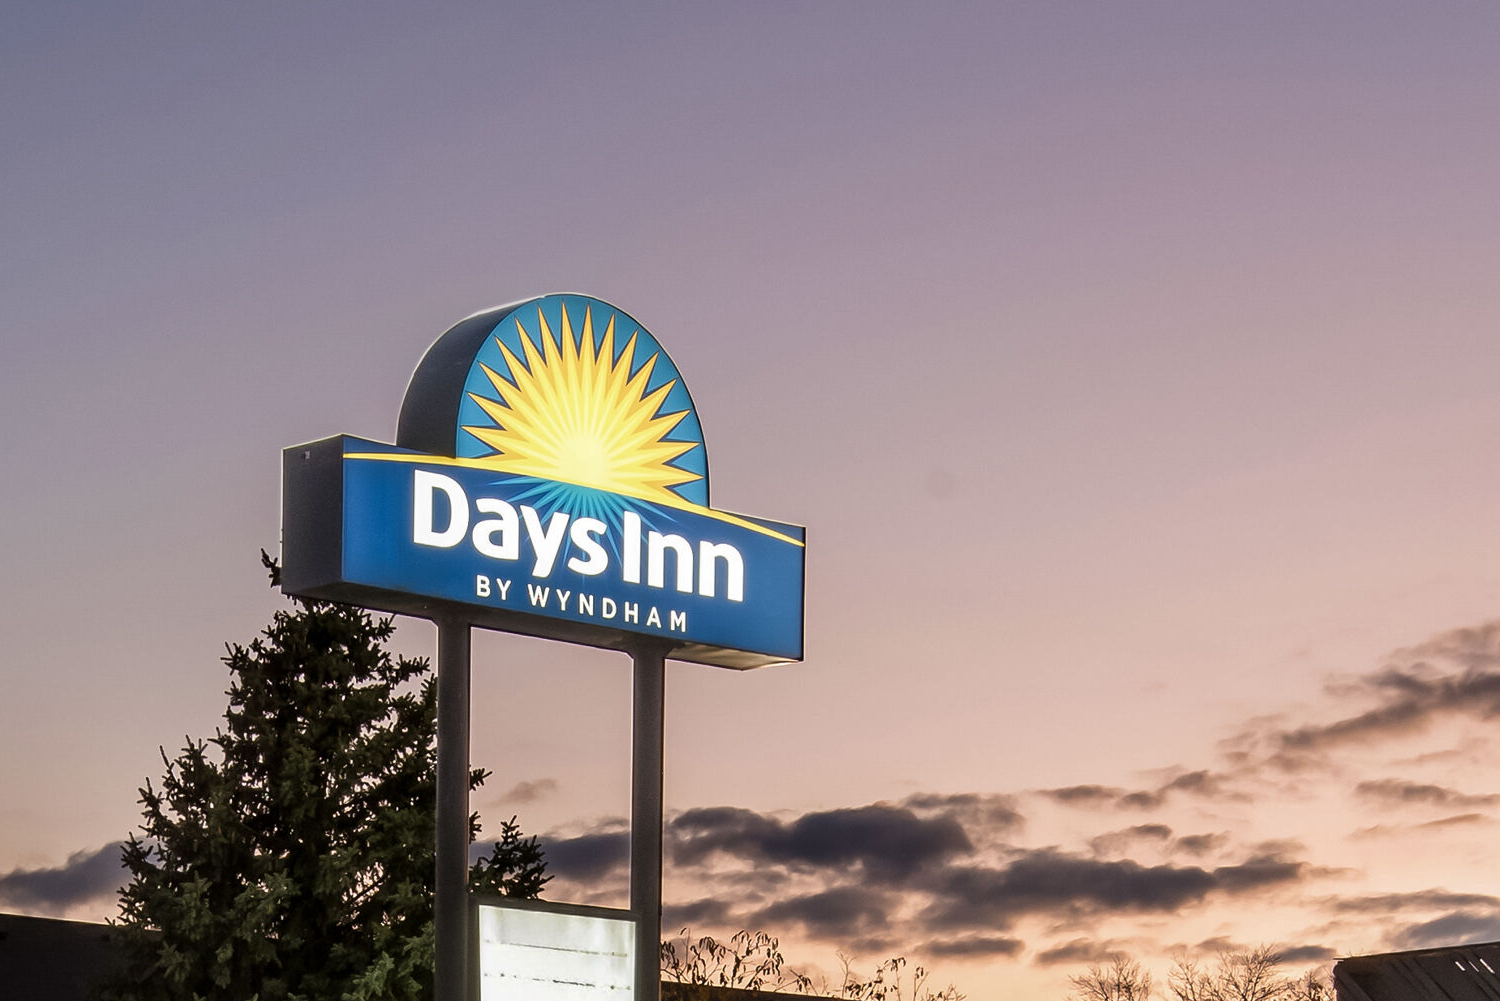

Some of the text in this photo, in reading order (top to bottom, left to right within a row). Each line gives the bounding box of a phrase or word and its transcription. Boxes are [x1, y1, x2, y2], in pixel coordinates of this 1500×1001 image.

[413, 469, 744, 602] Days Inn
[476, 575, 687, 632] BY WYNDHAM
